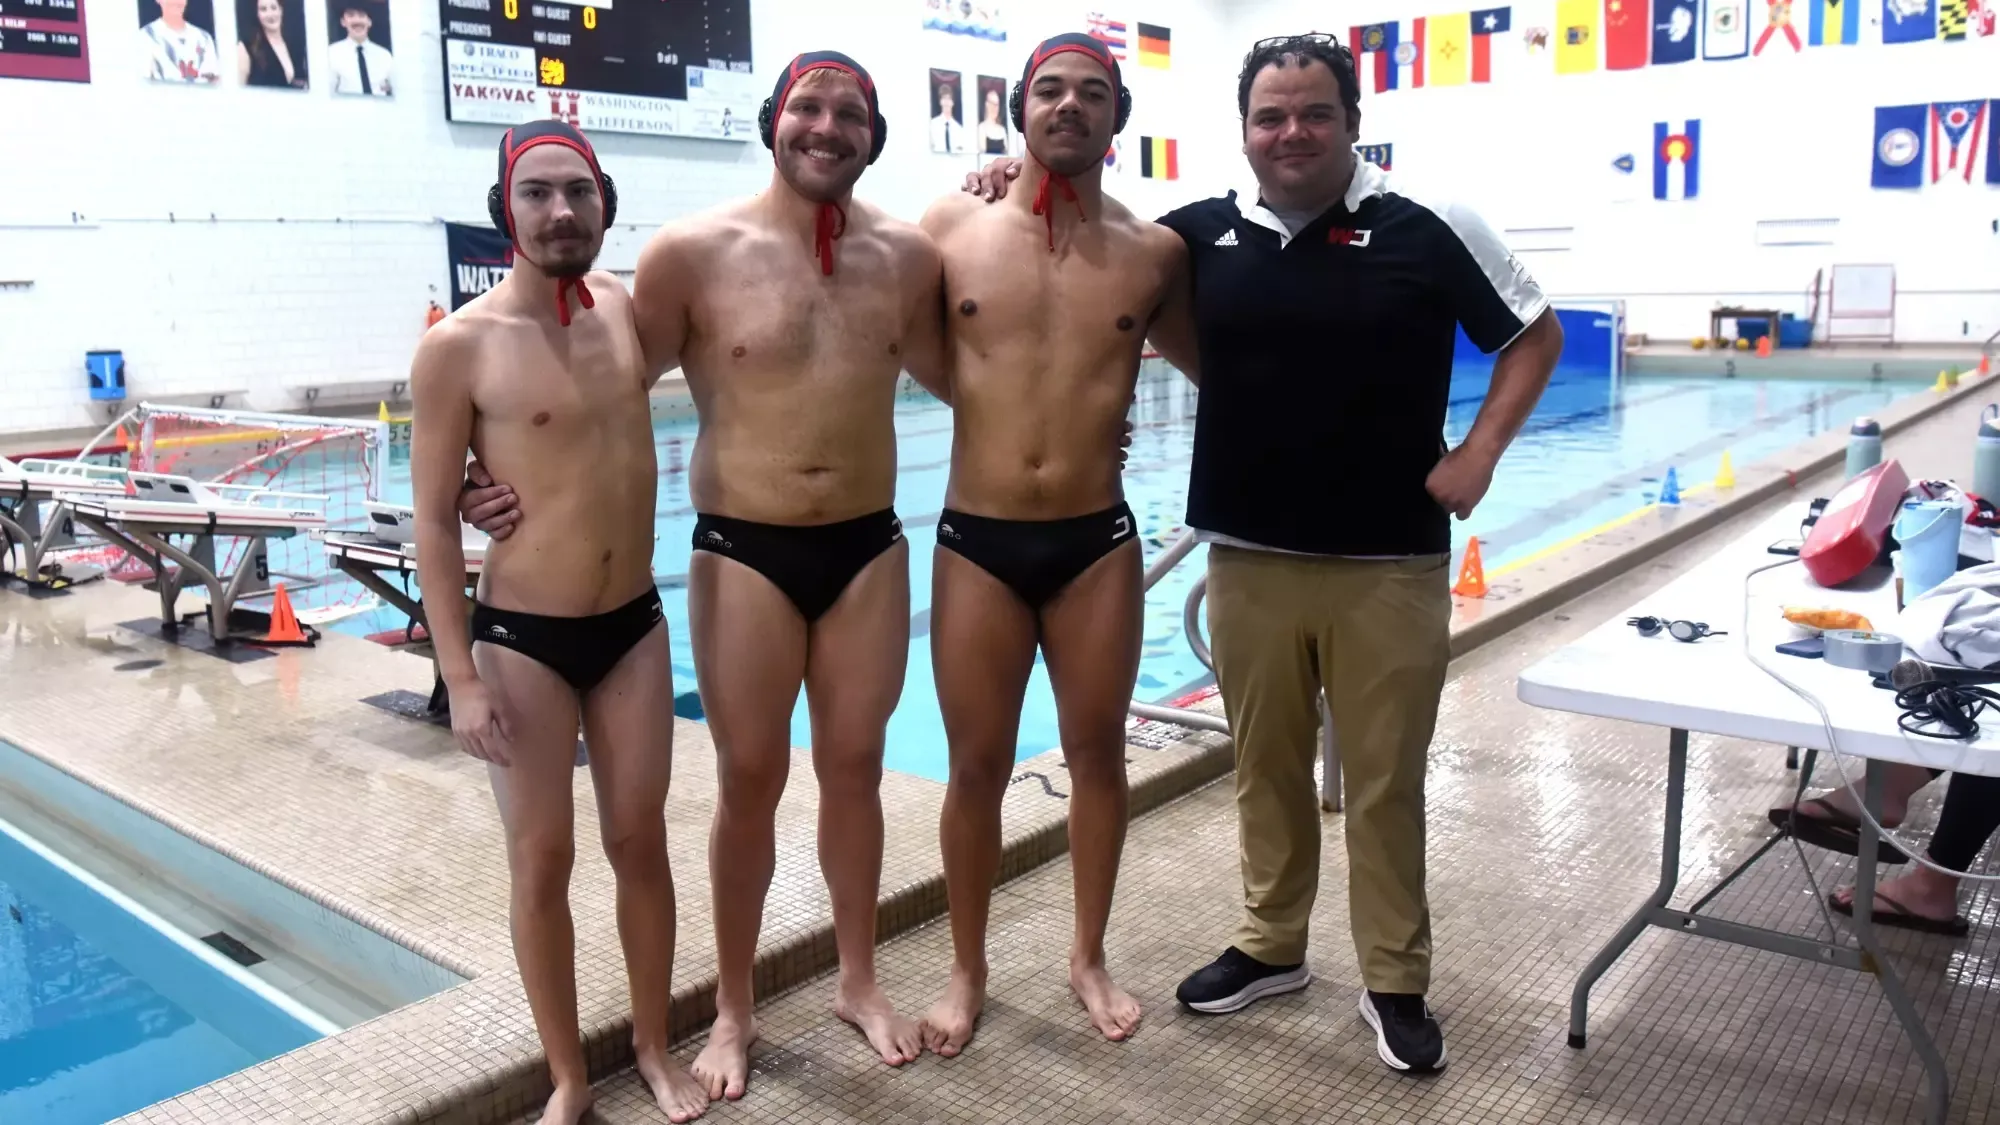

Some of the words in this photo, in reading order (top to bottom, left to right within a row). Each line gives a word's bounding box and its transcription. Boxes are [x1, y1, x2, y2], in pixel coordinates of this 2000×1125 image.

[504, 0, 518, 20] 0
[546, 6, 570, 21] GUEST
[583, 6, 596, 29] 0
[450, 20, 492, 37] PRESIDENTS
[547, 32, 571, 45] GUEST
[453, 84, 536, 103] YAKOVAC
[586, 95, 673, 112] WASHINGTON
[598, 116, 674, 132] JEFFERSON
[62, 516, 74, 538] 4
[700, 535, 732, 548] TURBO
[255, 555, 268, 580] 5
[485, 629, 516, 640] TURBO
